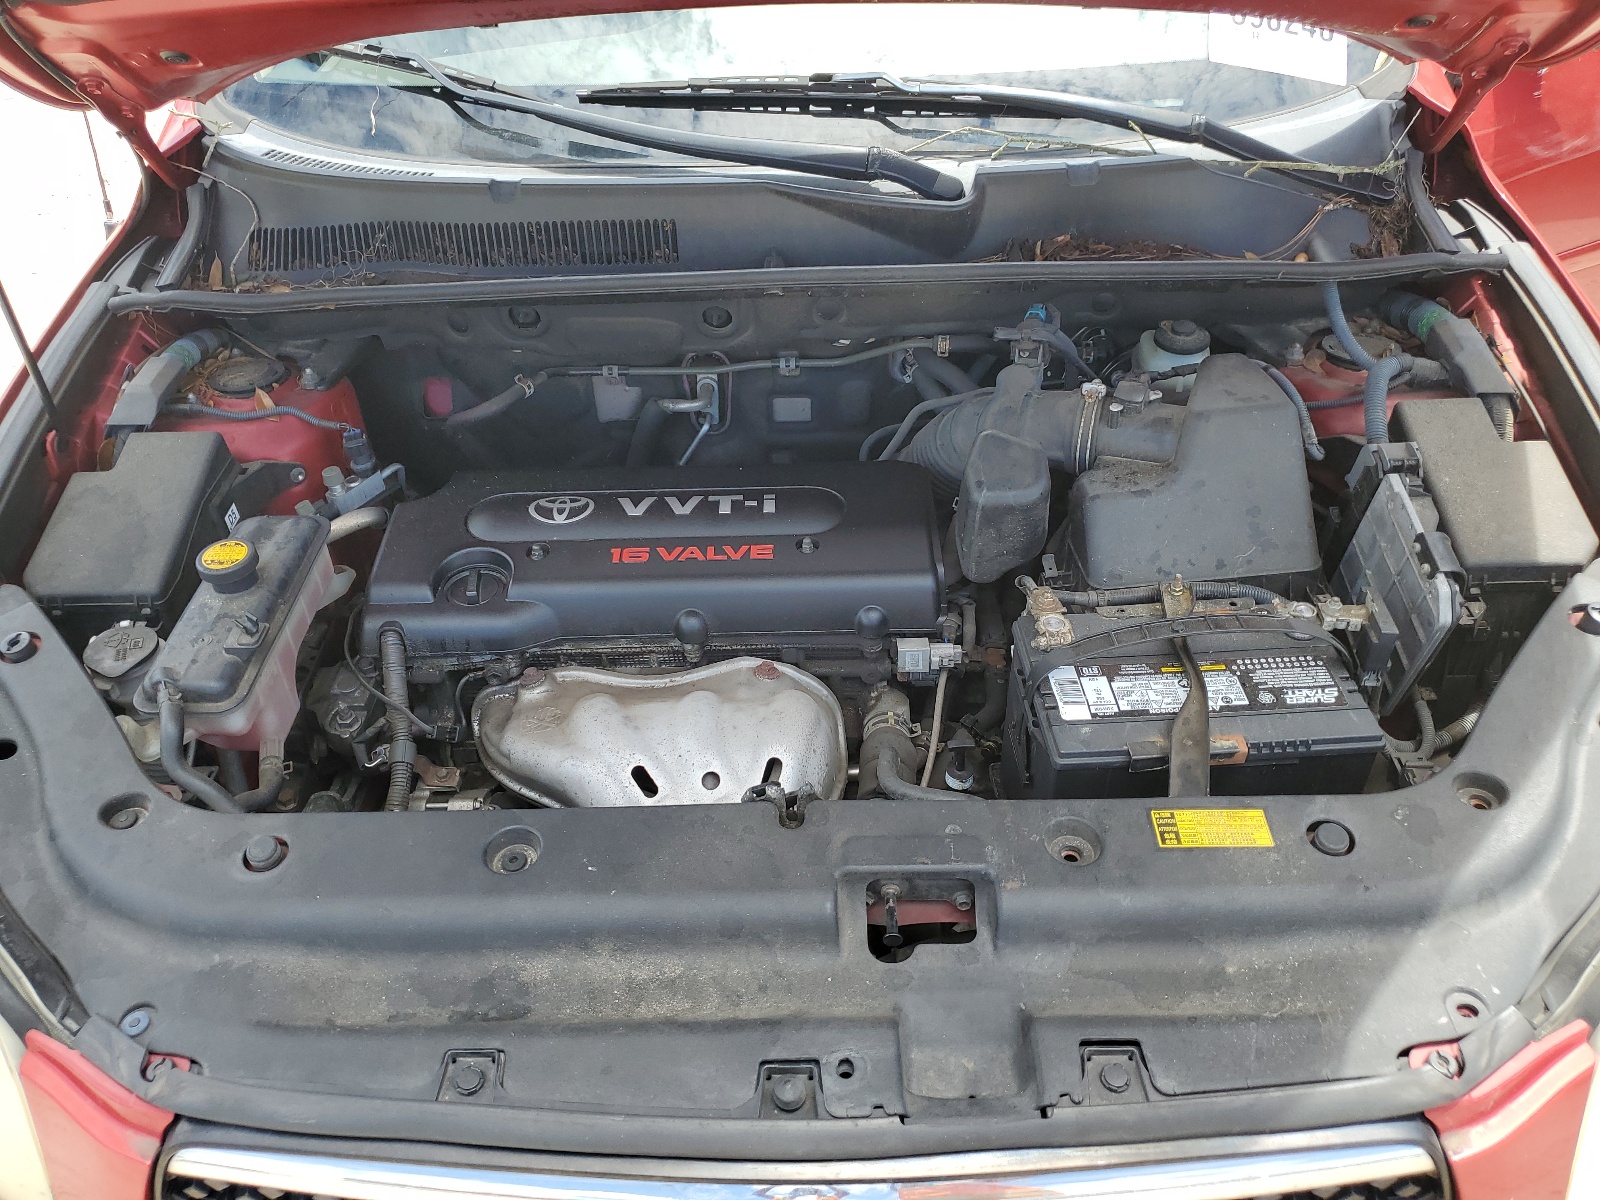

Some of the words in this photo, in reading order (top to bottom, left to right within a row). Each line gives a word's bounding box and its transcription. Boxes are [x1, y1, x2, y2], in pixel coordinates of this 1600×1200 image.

[617, 494, 777, 517] VVT-i
[611, 546, 650, 563] 16
[656, 543, 776, 562] VALVE
[1284, 686, 1338, 698] START
[1286, 696, 1336, 705] SUPER
